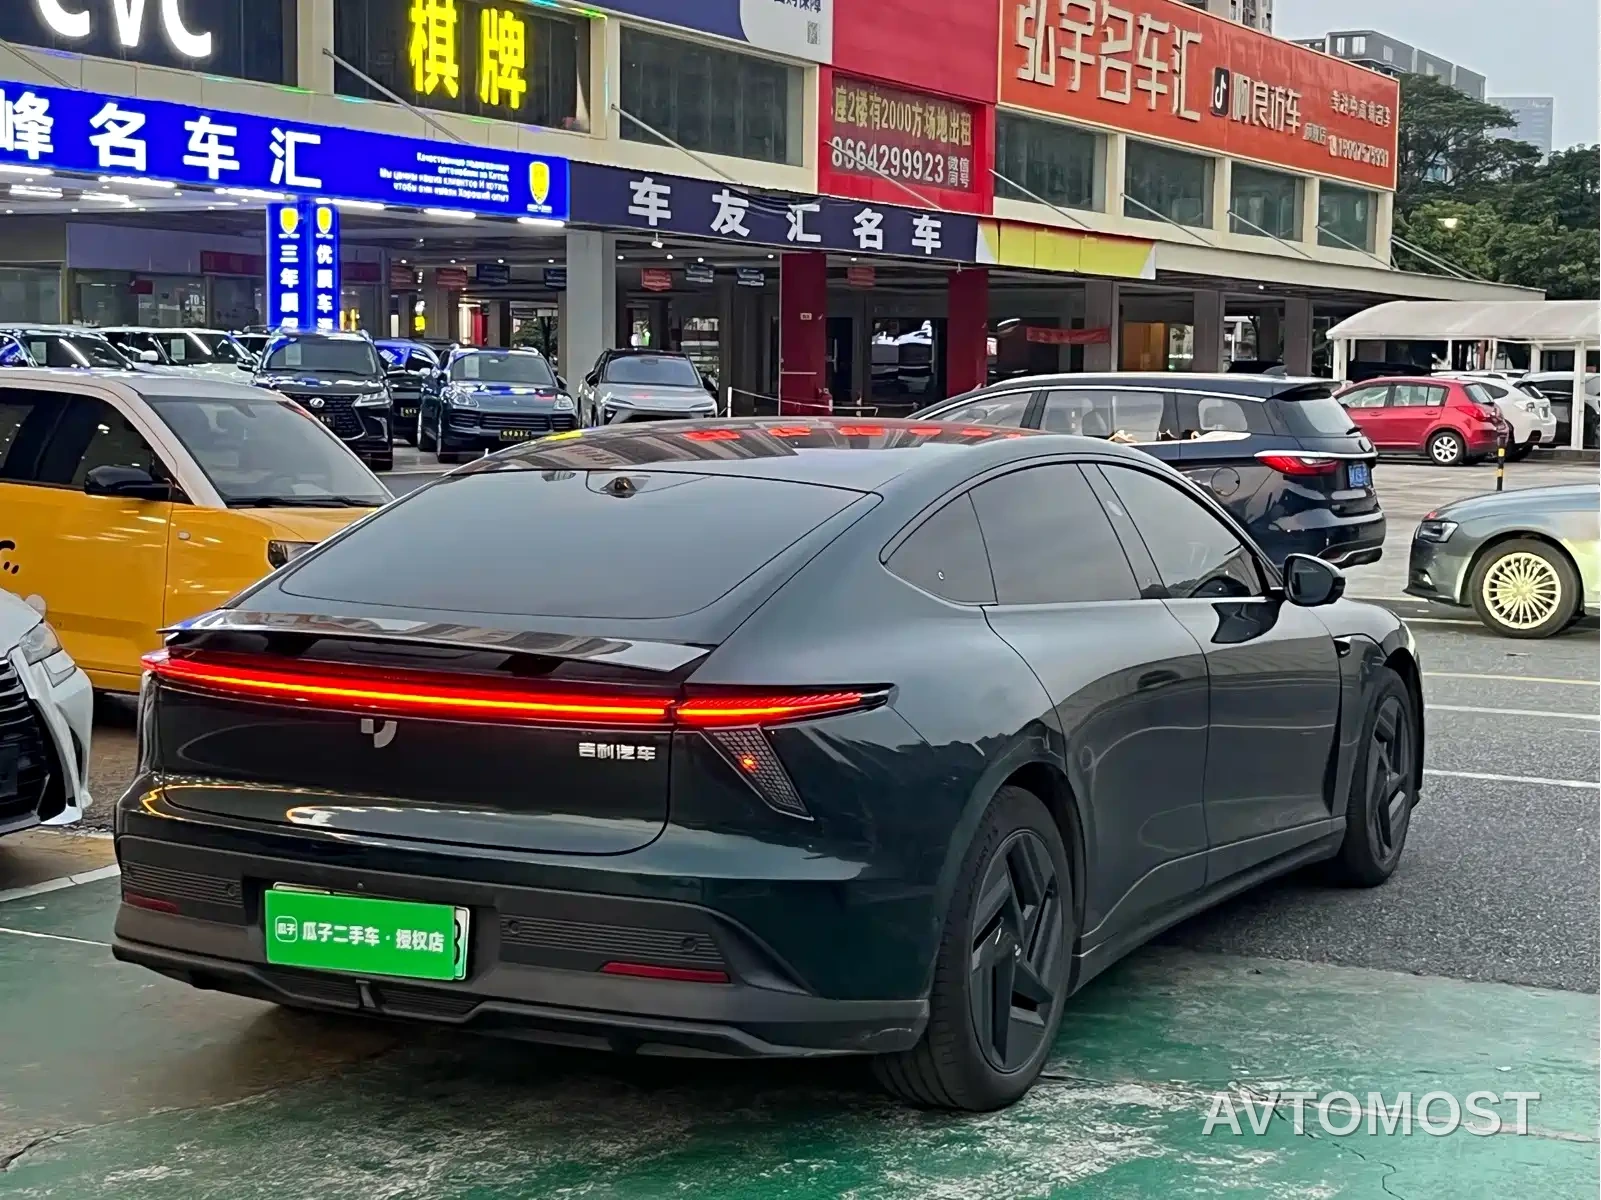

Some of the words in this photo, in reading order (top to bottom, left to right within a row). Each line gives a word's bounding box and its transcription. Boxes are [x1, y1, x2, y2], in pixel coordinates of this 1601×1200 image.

[410, 0, 527, 109] 棋牌
[1015, 0, 1203, 122] 弘宇名车汇
[628, 177, 943, 255] 车友汇名车
[579, 742, 656, 761] 吉利汽车
[277, 922, 296, 935] 瓜子
